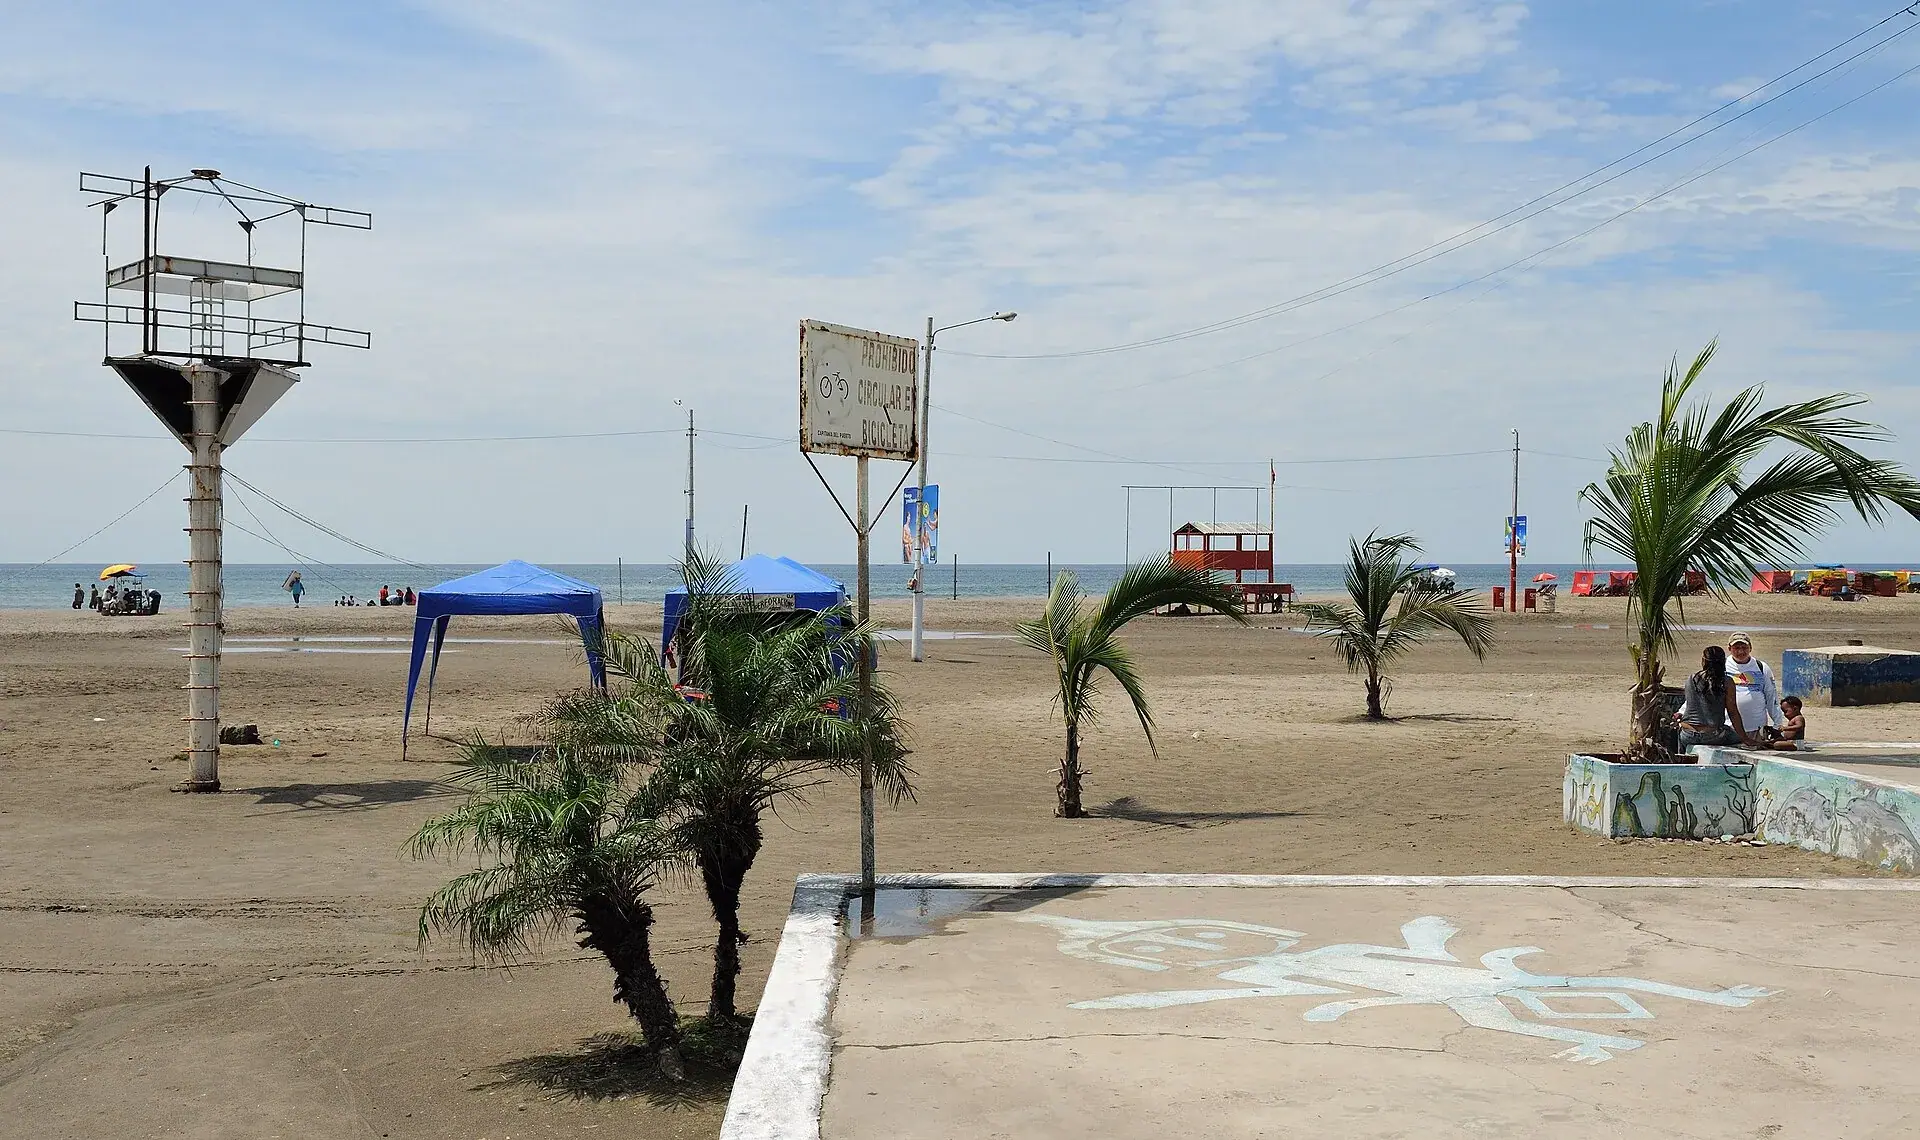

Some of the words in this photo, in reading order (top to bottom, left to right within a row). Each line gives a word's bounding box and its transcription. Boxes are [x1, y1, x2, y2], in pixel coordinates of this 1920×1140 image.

[861, 340, 915, 374] PROHIBIDO
[857, 379, 902, 411] CIRCULAR
[862, 419, 909, 450] BICICLETA
